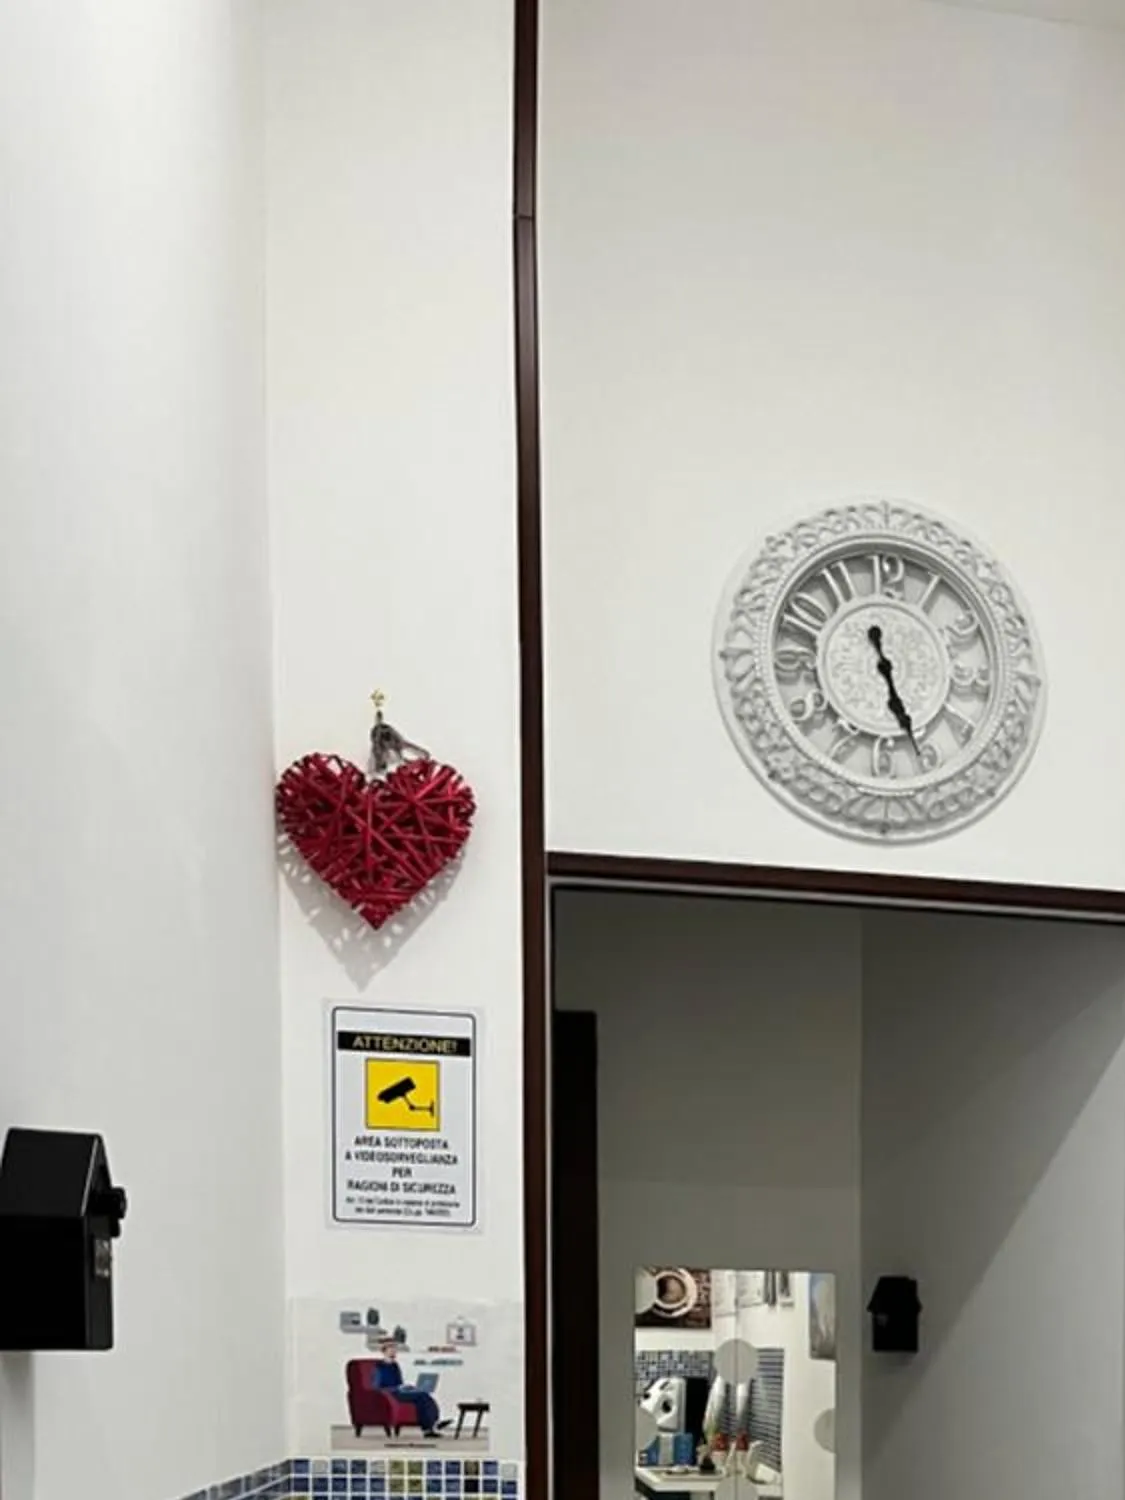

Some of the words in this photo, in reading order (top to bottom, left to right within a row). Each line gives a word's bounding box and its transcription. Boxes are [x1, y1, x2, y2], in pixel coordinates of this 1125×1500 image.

[816, 560, 857, 603] 11
[868, 554, 906, 600] 12
[920, 570, 942, 609] 1
[783, 592, 830, 635] 10
[788, 688, 829, 721] 8
[352, 1034, 458, 1054] ATTENZIONE!
[354, 1136, 382, 1147] AREA
[384, 1136, 449, 1150] SOTTOPOSTA
[345, 1150, 352, 1161] A
[354, 1150, 459, 1165] VIDEOSORVEGLIANZA
[391, 1166, 413, 1178] PER
[346, 1179, 388, 1192] RAGIONI
[390, 1181, 400, 1192] DI
[402, 1181, 456, 1195] SICUREZZA
